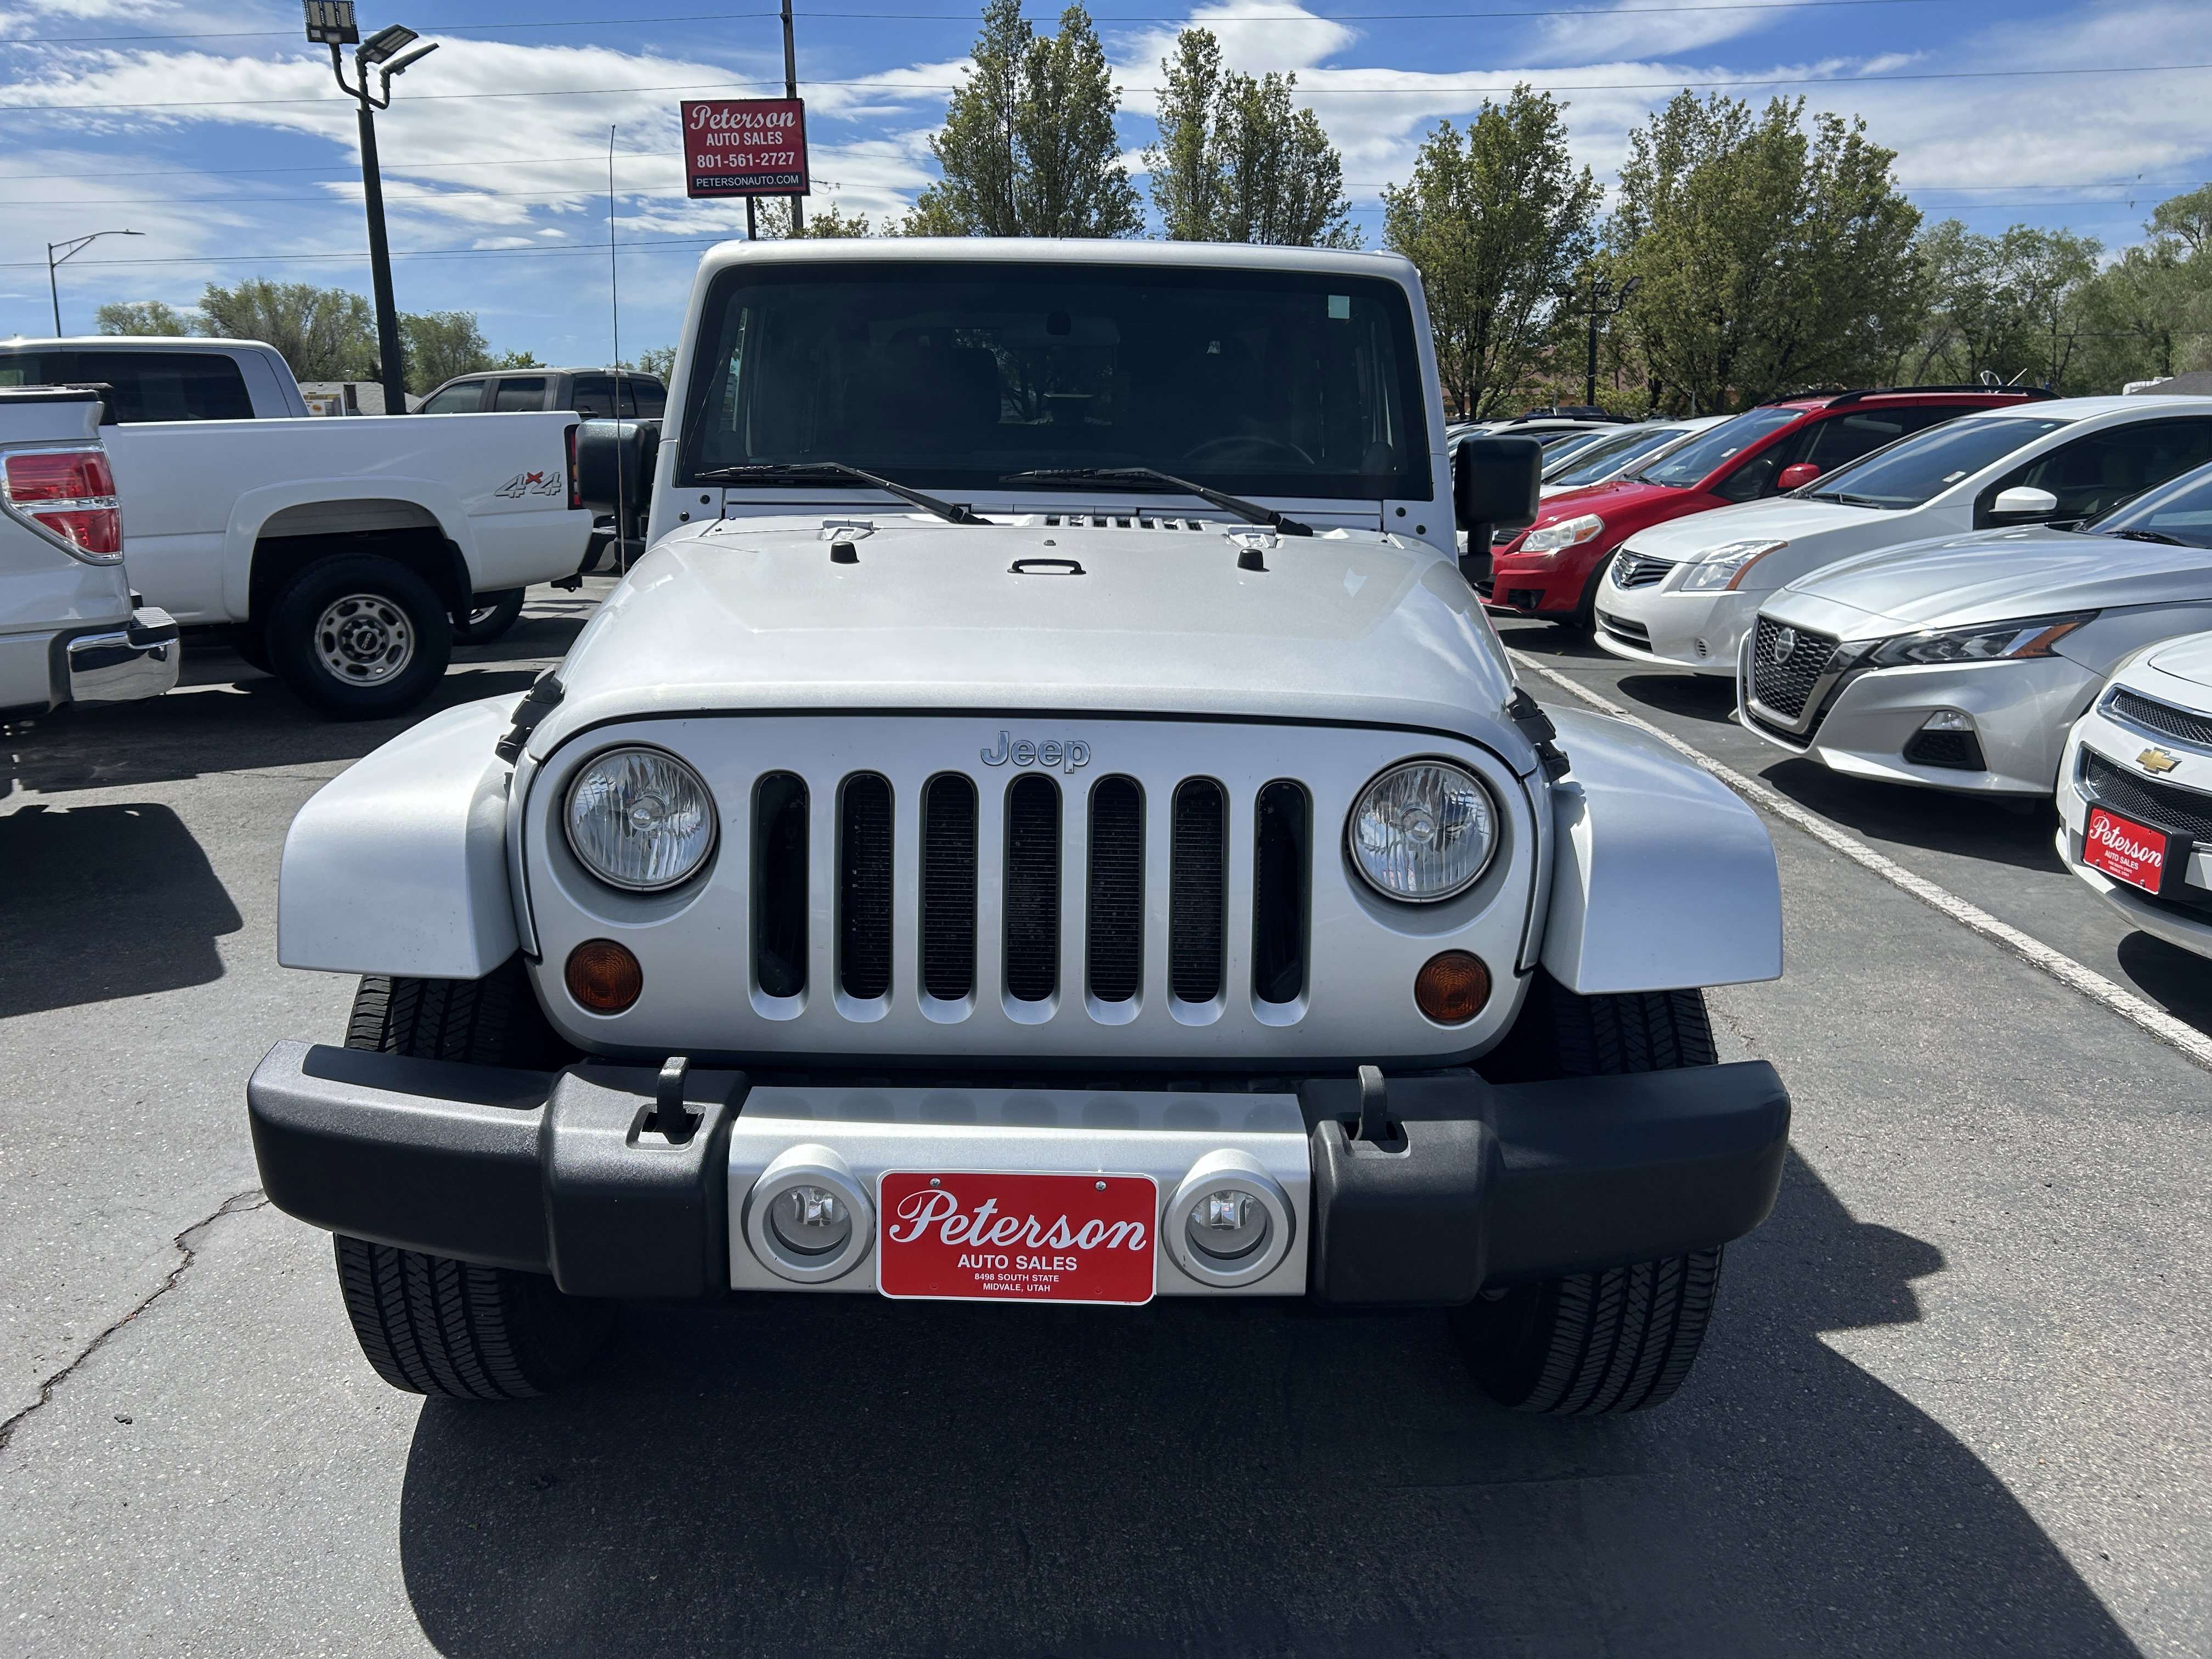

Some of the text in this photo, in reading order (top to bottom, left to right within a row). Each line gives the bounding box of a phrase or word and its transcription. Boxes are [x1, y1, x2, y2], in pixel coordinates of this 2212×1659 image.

[690, 105, 795, 130] Peterson
[706, 131, 783, 146] AUTO SALES
[697, 151, 795, 168] 801-561-2727
[696, 175, 799, 187] PETERSONAUTO.COM
[980, 730, 1091, 774] Jeep
[2089, 816, 2162, 867] Peterson
[2104, 849, 2119, 862] AUTO
[2120, 856, 2138, 870] SALES
[889, 1189, 1147, 1251] Peterson
[957, 1254, 1077, 1271] AUTO SALES
[997, 1273, 1029, 1282] SOUTH
[983, 1283, 1024, 1292] MIDVALE,
